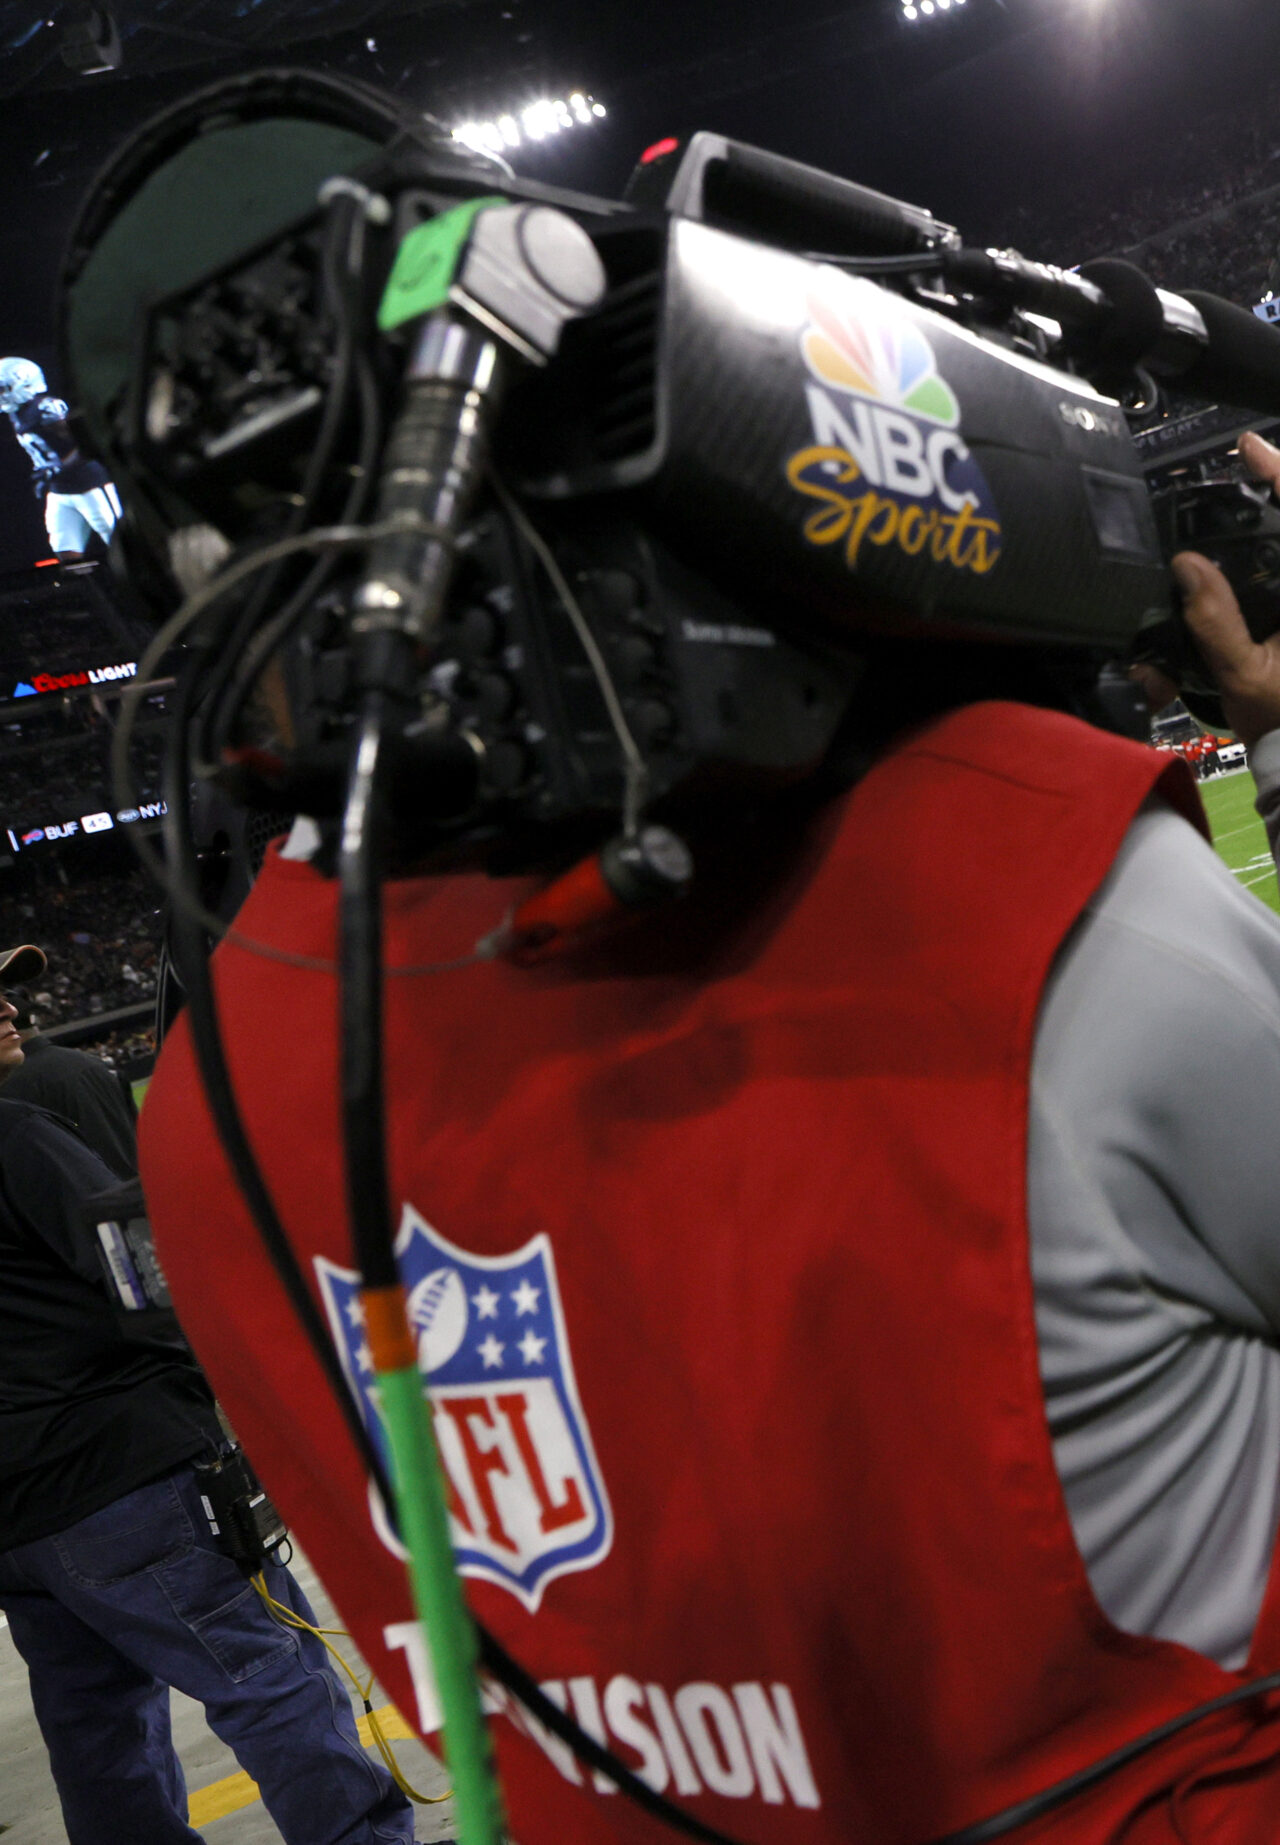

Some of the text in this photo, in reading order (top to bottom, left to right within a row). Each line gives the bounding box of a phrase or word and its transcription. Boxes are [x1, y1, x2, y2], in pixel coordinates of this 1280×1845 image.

[785, 444, 1002, 574] Sports
[806, 381, 981, 513] NBC
[88, 662, 138, 684] LIGHT
[44, 820, 79, 840] BUF
[138, 801, 168, 819] NYJ
[430, 1391, 589, 1555] FL
